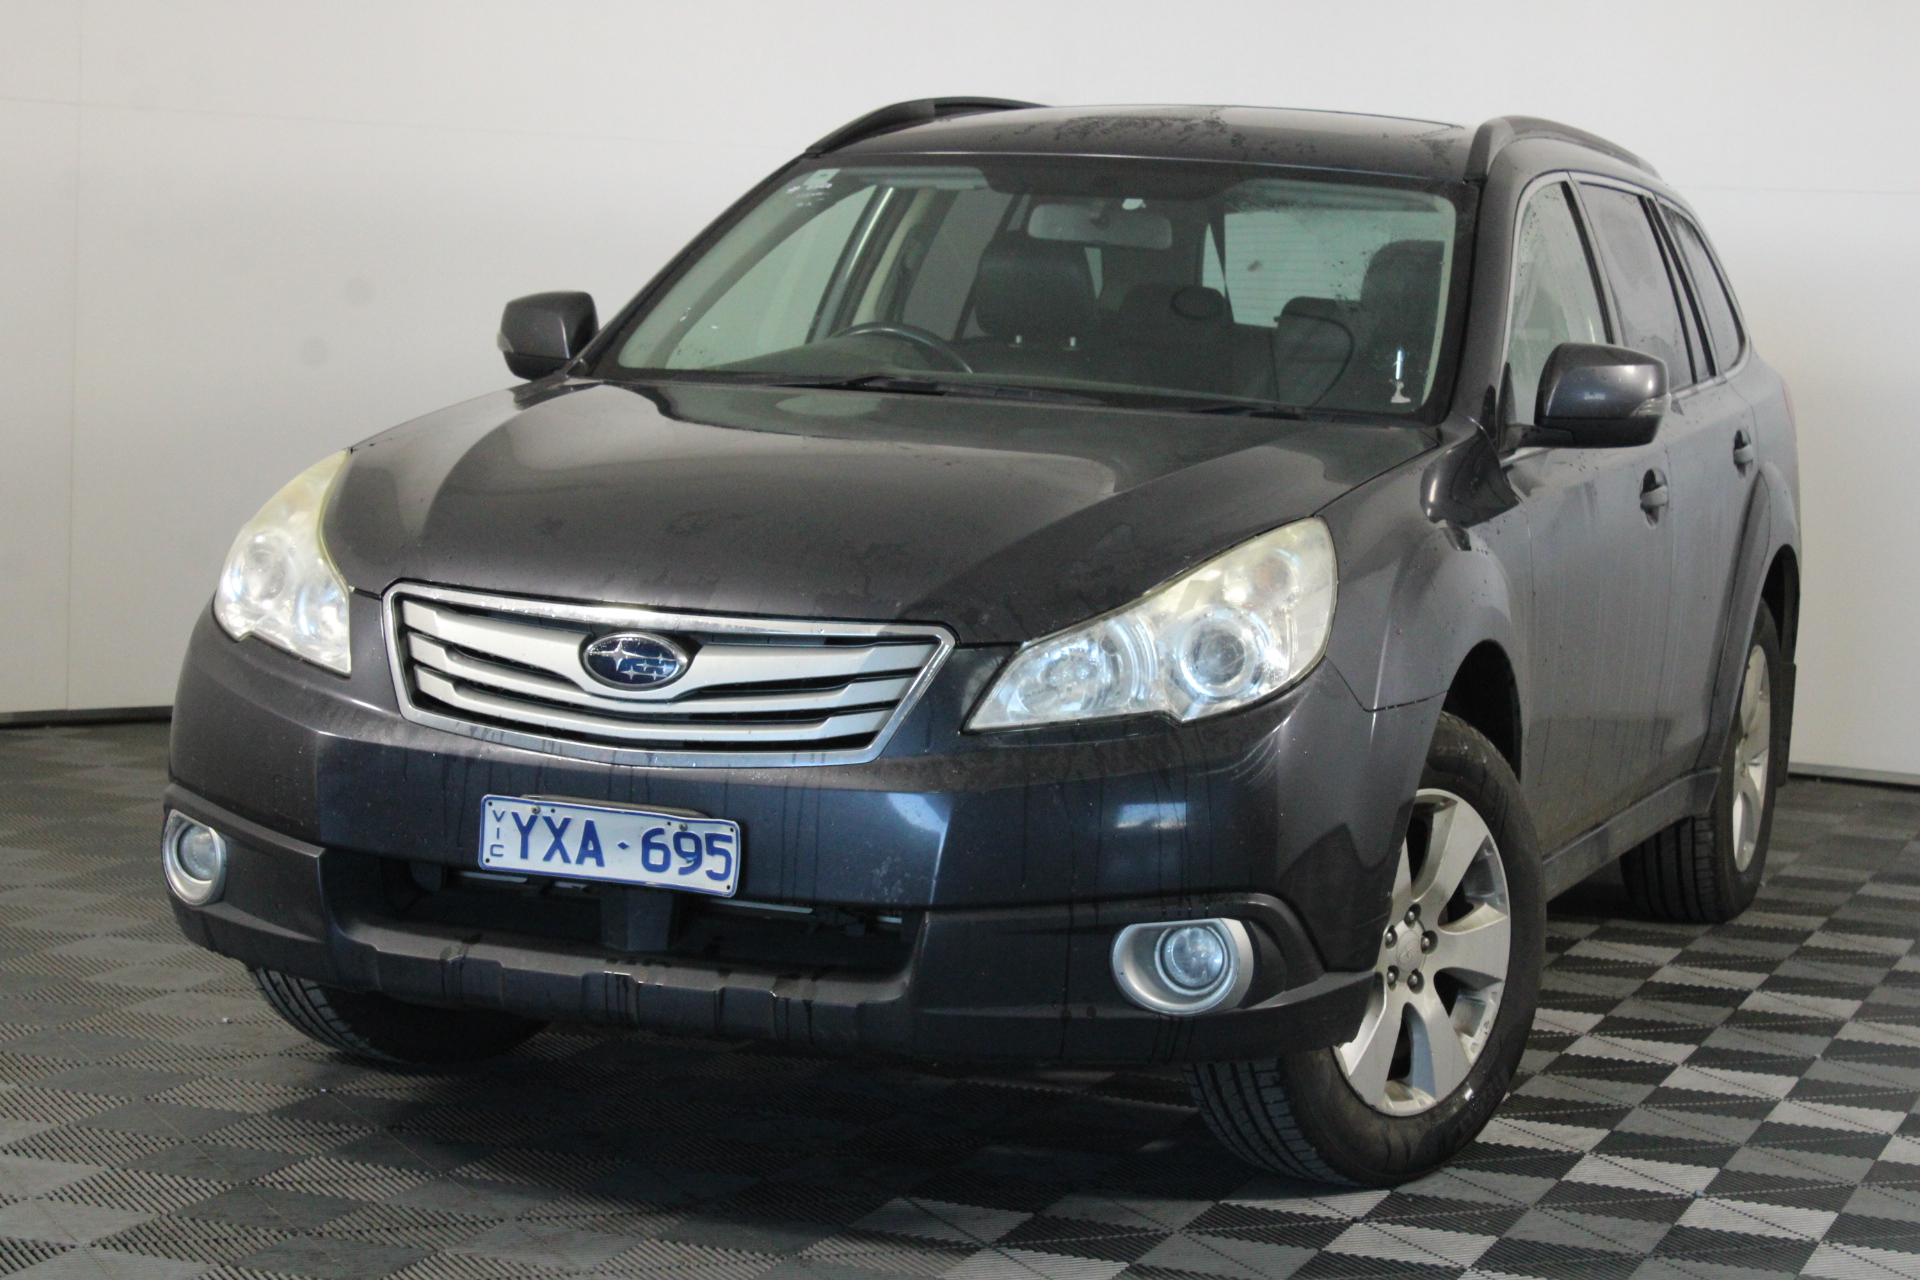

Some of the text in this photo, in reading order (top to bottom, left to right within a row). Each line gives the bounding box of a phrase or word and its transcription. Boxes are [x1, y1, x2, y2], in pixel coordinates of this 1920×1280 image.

[490, 809, 505, 858] VIC
[511, 811, 733, 881] YXA 695
